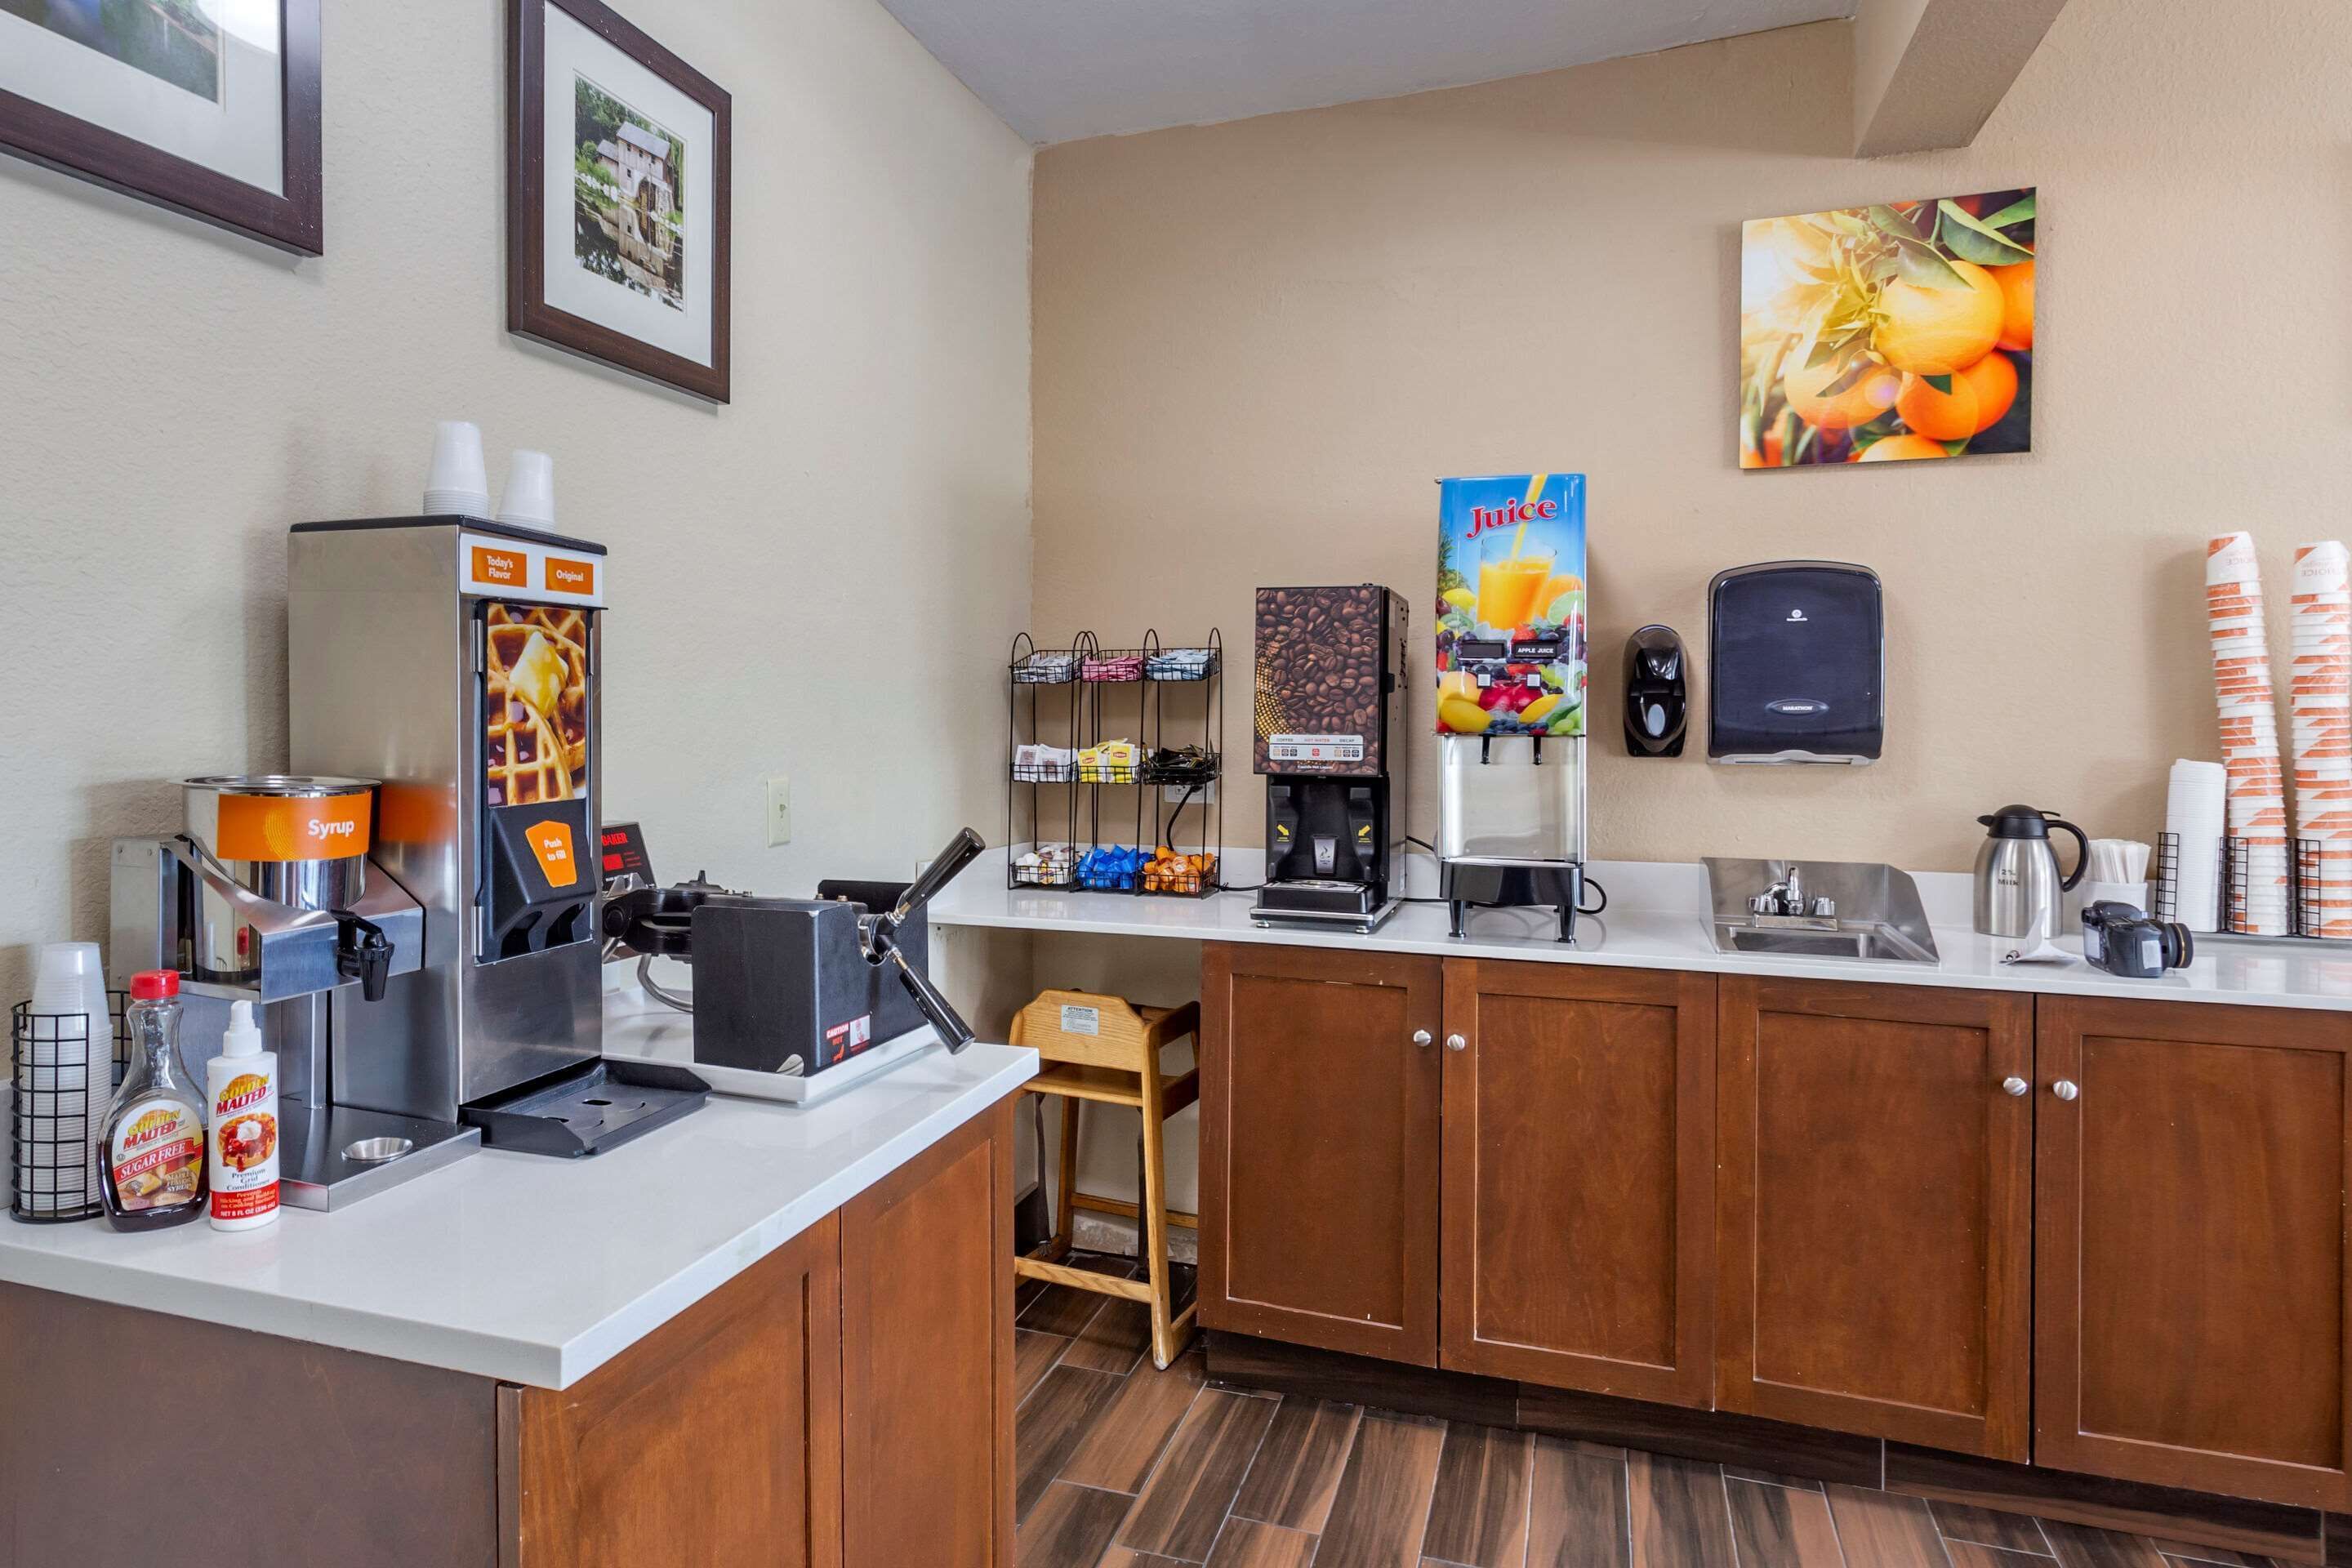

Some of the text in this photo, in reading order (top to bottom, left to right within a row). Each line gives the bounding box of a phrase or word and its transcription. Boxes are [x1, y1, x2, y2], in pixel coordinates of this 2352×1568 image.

[1466, 498, 1557, 539] Juice
[487, 555, 514, 570] Today's
[488, 567, 512, 580] Flavor
[556, 569, 584, 582] Original
[307, 818, 355, 840] Syrup
[543, 836, 563, 849] Push
[546, 849, 567, 861] to fill
[1998, 878, 2020, 886] Milk
[826, 1022, 849, 1040] CAUTION
[219, 1073, 270, 1102] GOLDEN
[216, 1086, 267, 1116] MALTED
[127, 1109, 180, 1137] GOLDEN
[123, 1120, 177, 1150] MALTED
[120, 1143, 186, 1179] SUGAR FREE
[231, 1169, 266, 1178] Premium
[226, 1178, 271, 1192] Conditioner
